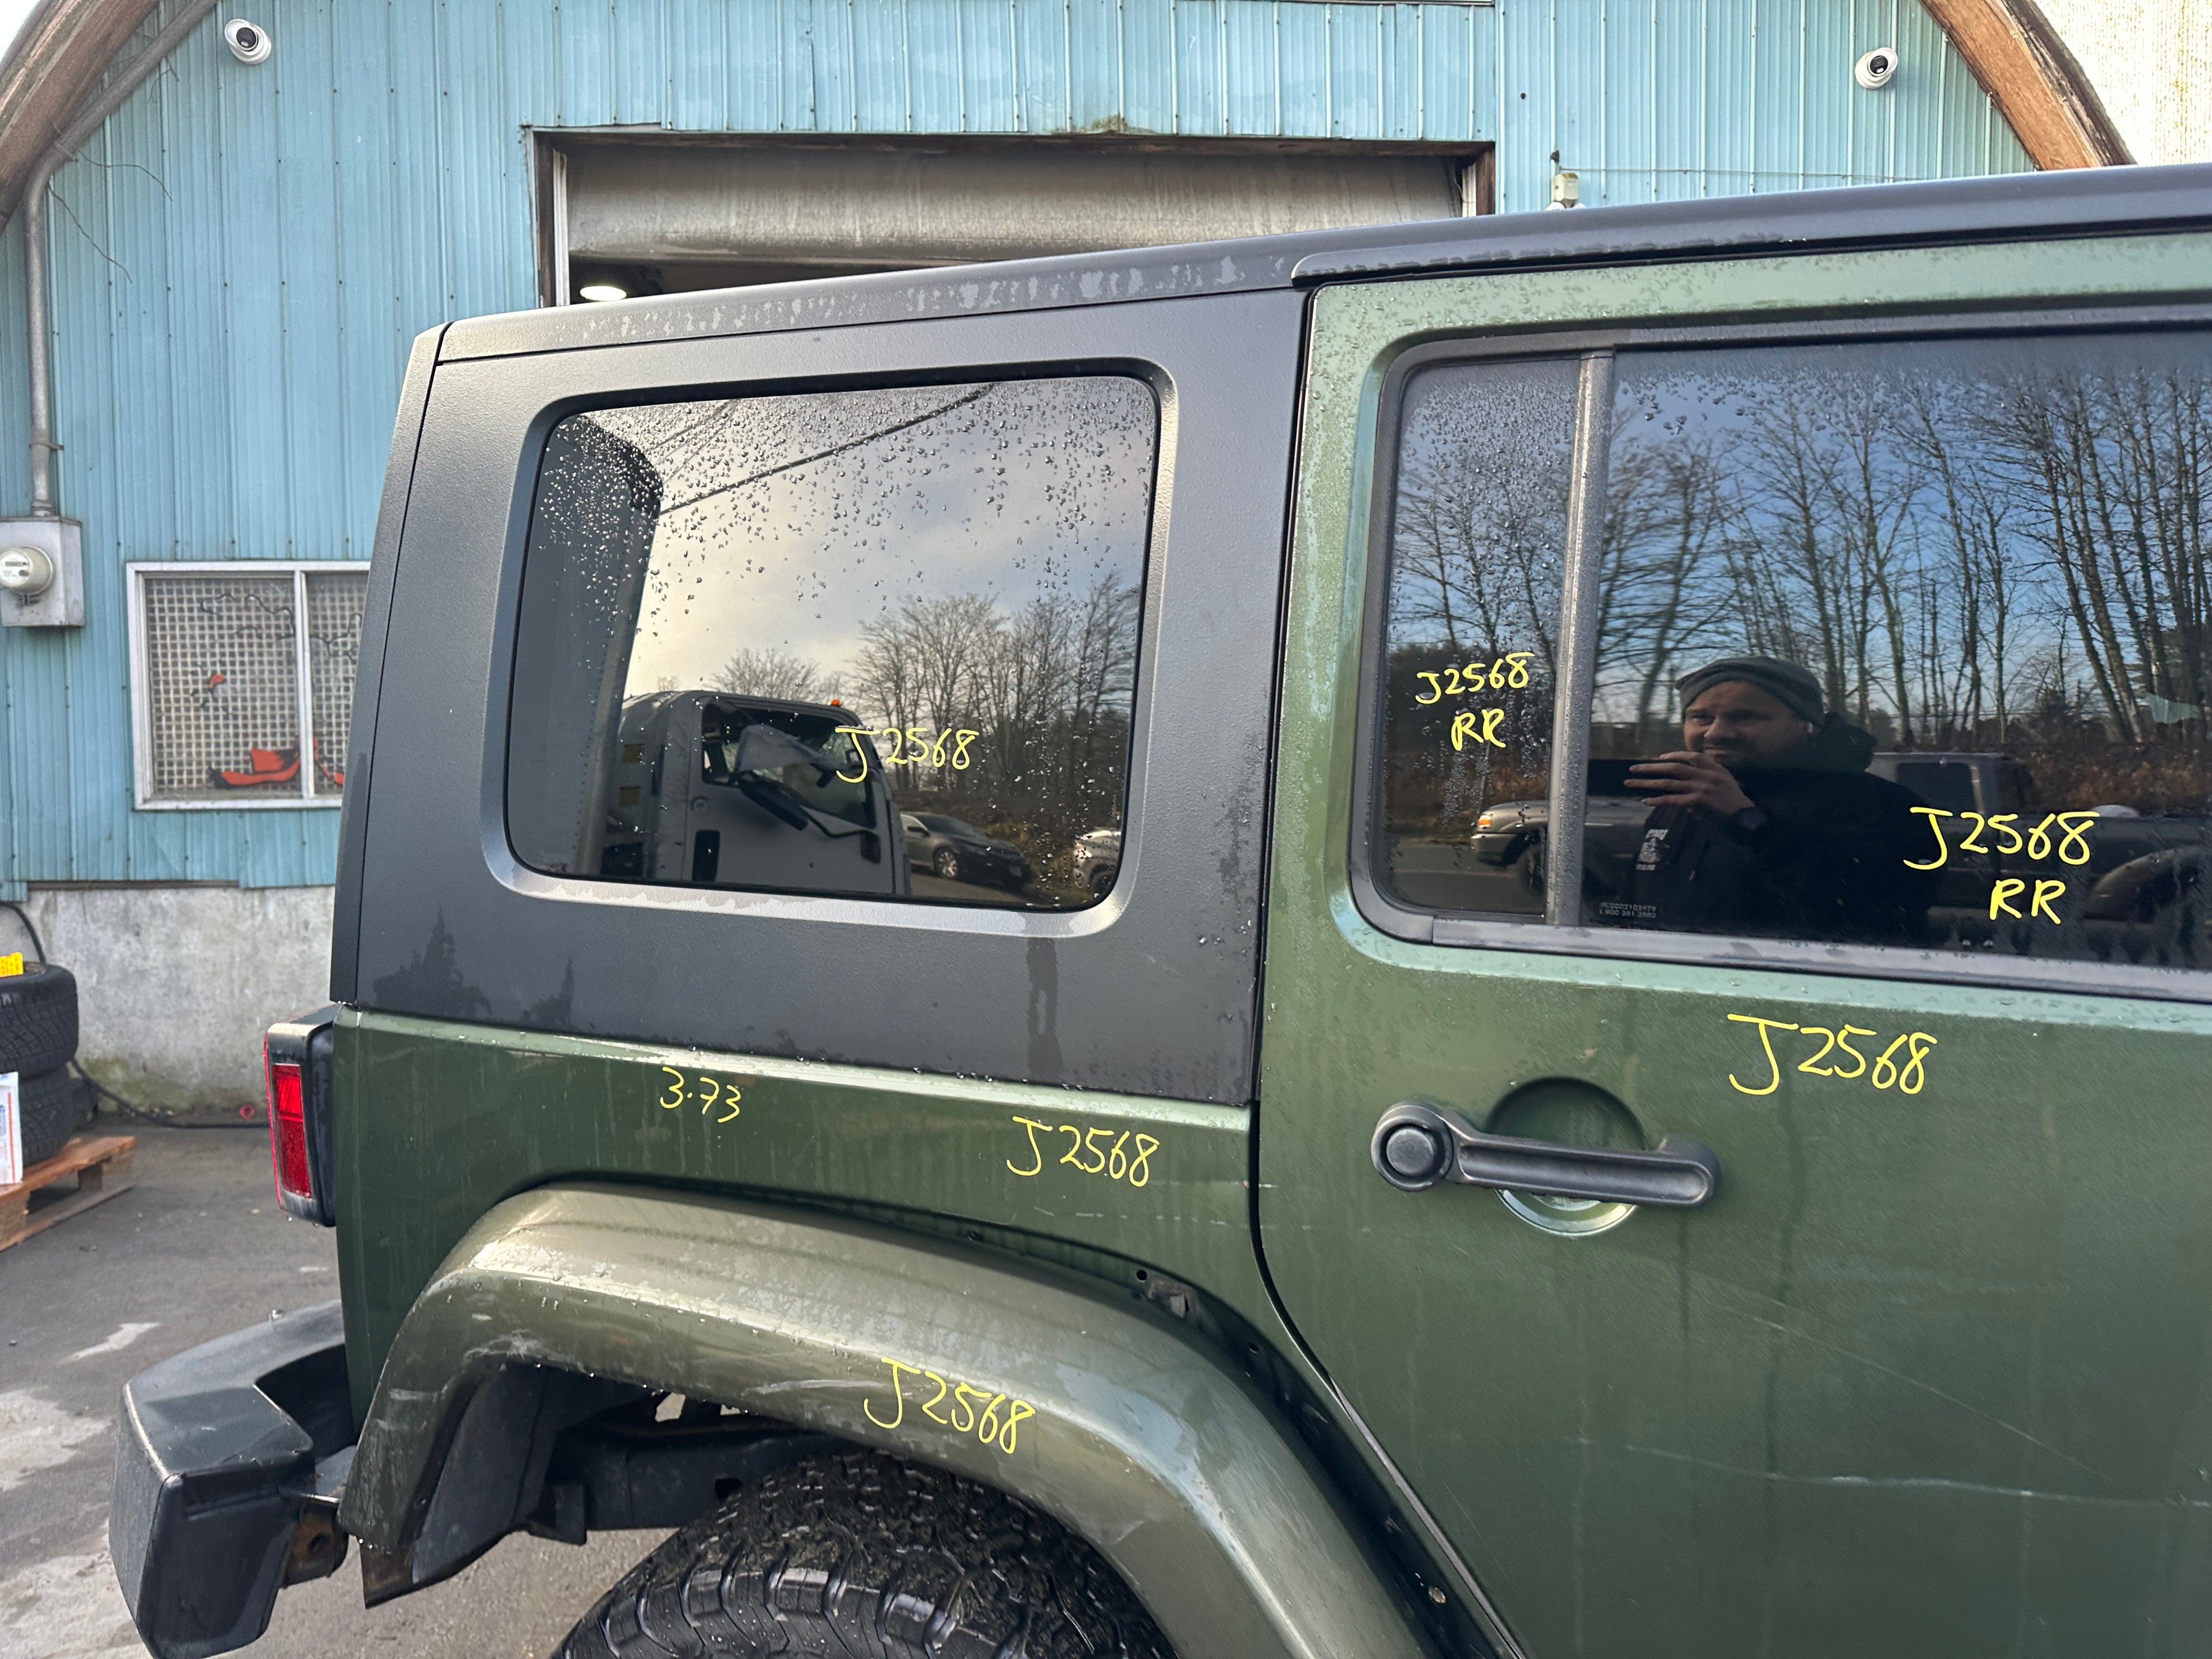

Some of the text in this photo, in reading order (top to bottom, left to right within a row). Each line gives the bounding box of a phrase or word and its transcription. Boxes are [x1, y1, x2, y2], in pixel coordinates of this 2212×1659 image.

[1415, 652, 1535, 704] J2568
[835, 727, 979, 783] J2568
[1451, 709, 1506, 751] RR
[1903, 806, 2100, 870] J2568
[1989, 878, 2066, 924] RR
[1727, 1014, 1937, 1095] J2568
[660, 1066, 741, 1123] 3.73
[1006, 1116, 1160, 1187] J2568
[863, 1357, 1035, 1454] J2568
